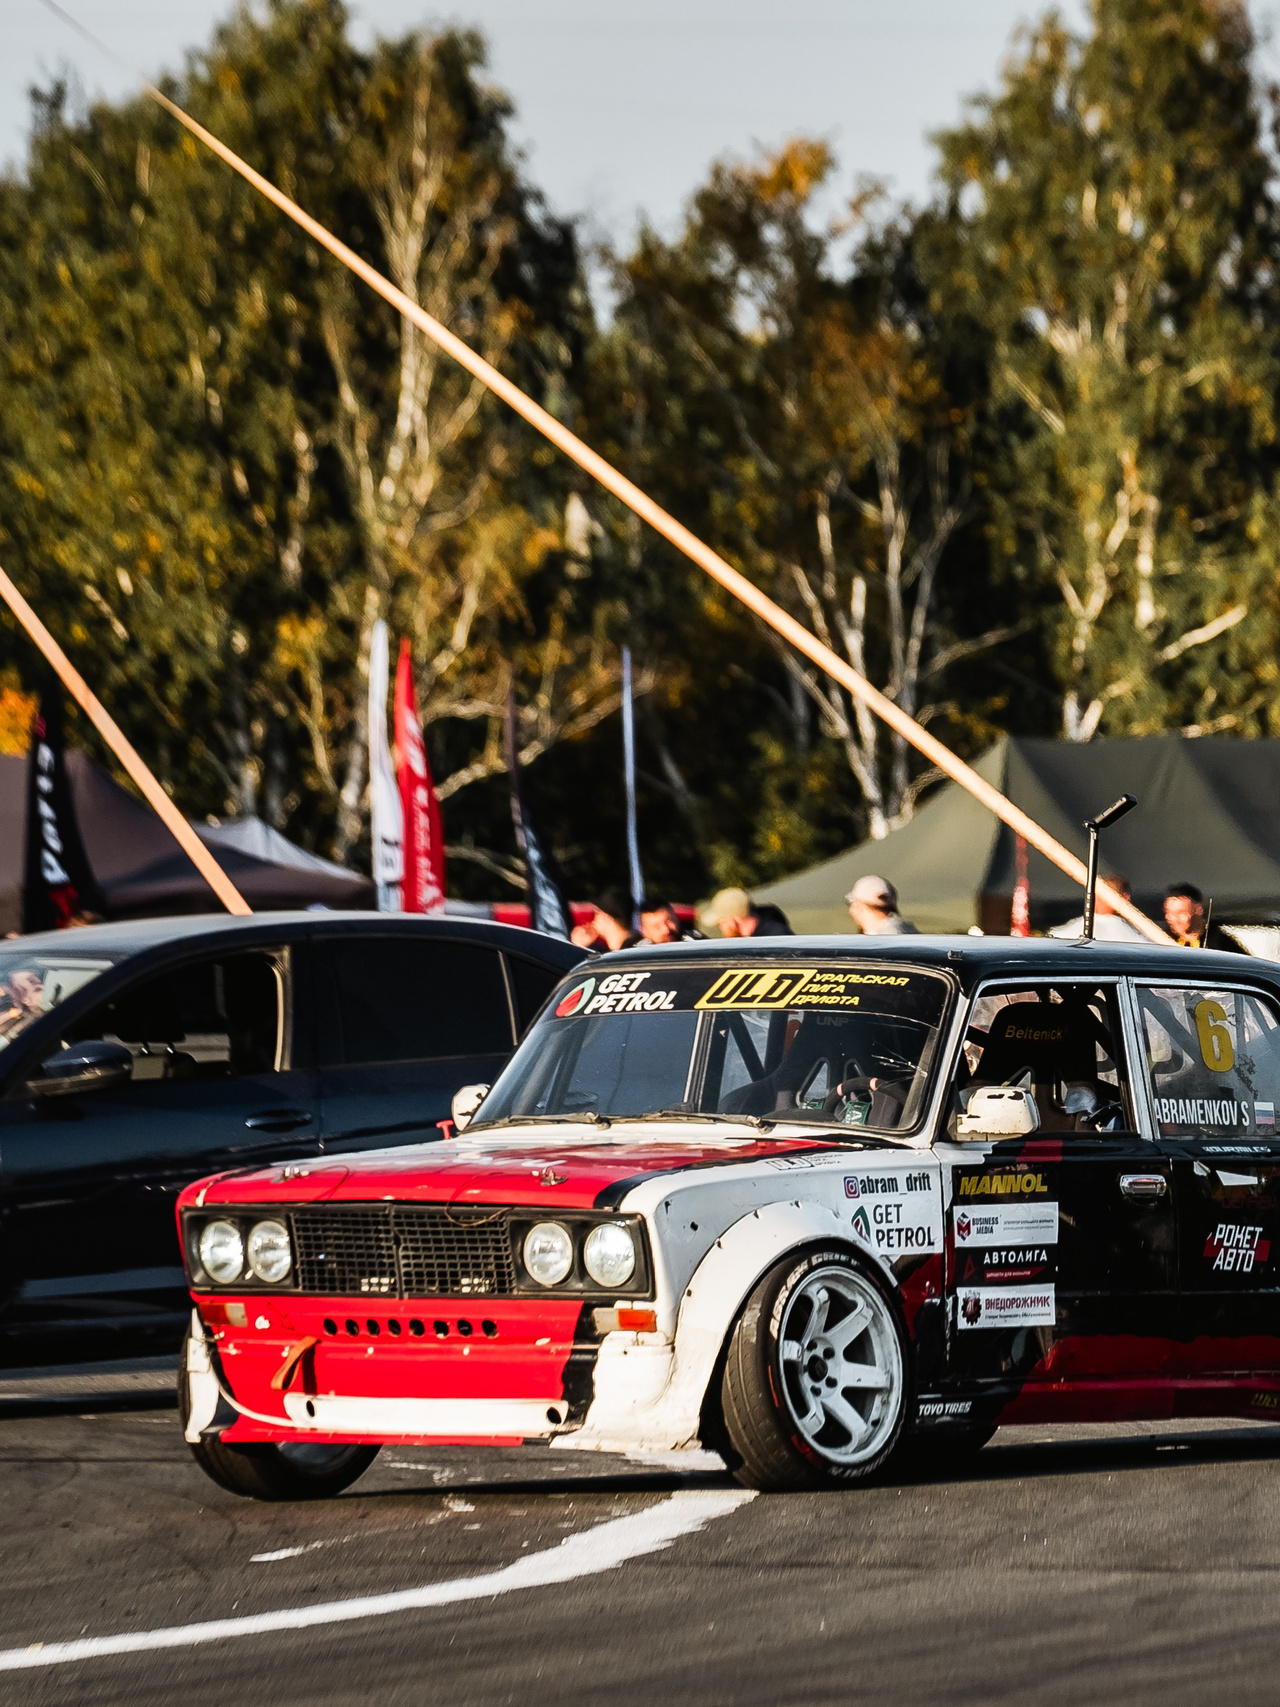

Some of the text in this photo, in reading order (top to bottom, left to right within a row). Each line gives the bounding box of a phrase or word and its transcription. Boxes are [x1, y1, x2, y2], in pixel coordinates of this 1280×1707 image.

[598, 972, 651, 993] GET
[801, 984, 846, 993] ЛИГА
[813, 973, 910, 986] УРАЛЬСКАЯ
[584, 991, 677, 1014] PETROL
[790, 995, 860, 1006] ДРИФТА
[1195, 1000, 1234, 1072] 6
[1154, 1098, 1250, 1127] ABRAMENKOV S
[859, 1173, 931, 1195] abram_drift
[959, 1173, 1048, 1195] MANNOL
[873, 1204, 903, 1225] GET
[972, 1217, 999, 1226] BUSINESS
[875, 1226, 935, 1248] PETROL
[976, 1226, 994, 1235] MEDIA
[1213, 1223, 1263, 1249] РОКЕТ
[983, 1249, 1048, 1265] АВТОЛИГА
[1212, 1247, 1255, 1273] АВТО
[985, 1296, 1050, 1312] ВНЕДОРОЖНИК
[918, 1400, 973, 1416] TOYO TIRES
